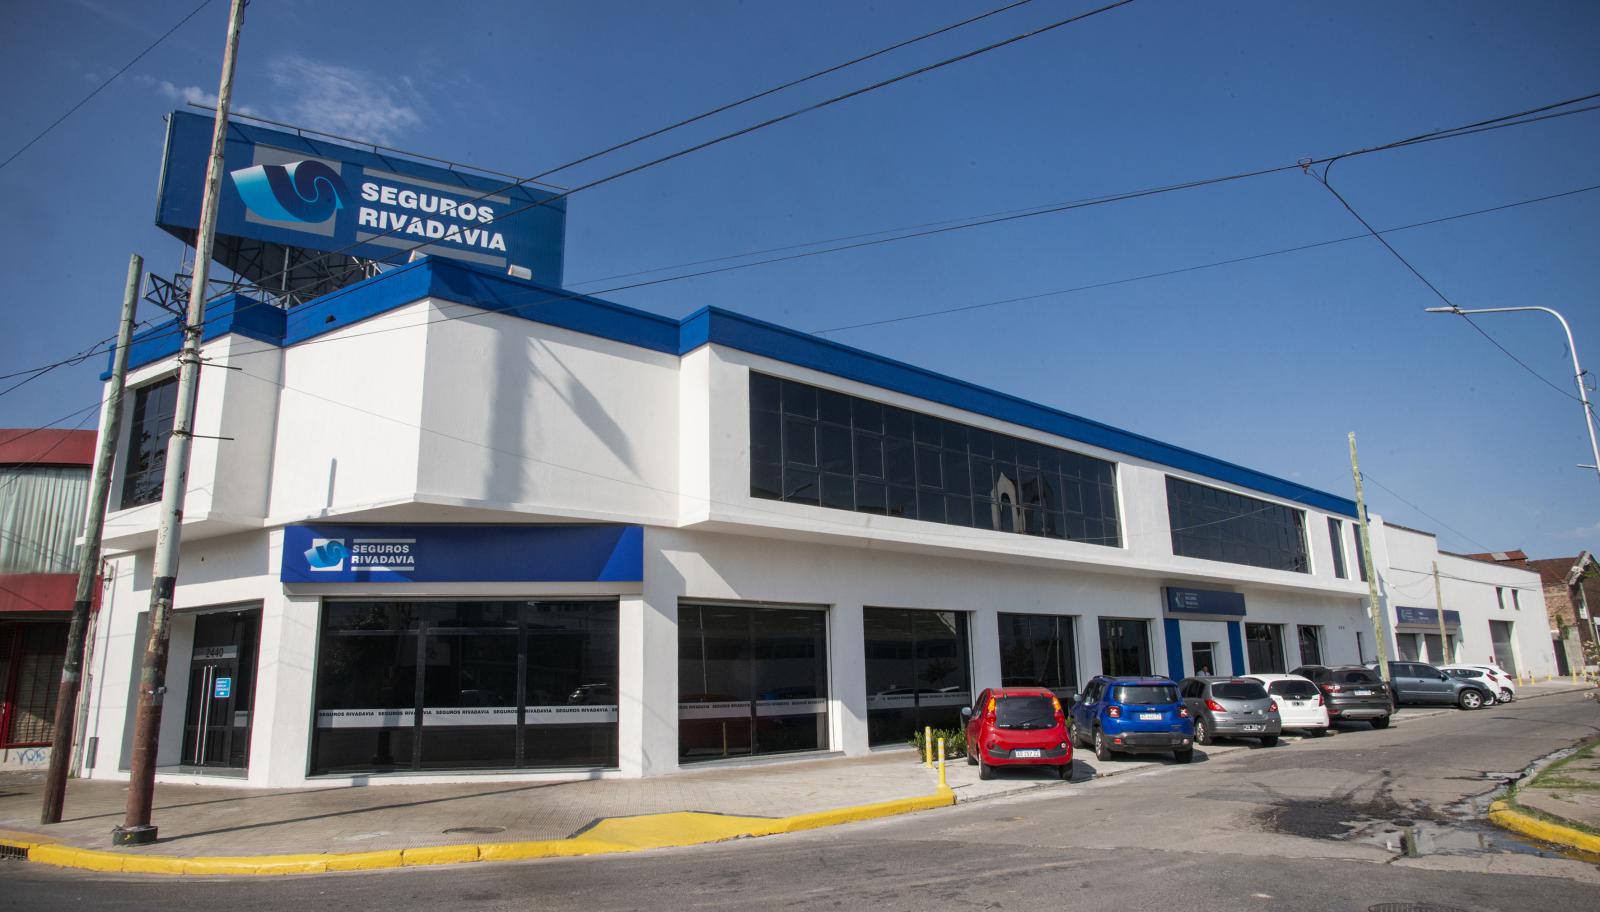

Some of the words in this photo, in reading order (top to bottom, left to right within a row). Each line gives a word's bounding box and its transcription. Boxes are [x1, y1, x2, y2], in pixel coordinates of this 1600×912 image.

[360, 182, 495, 224] SEGUROS
[358, 207, 507, 251] RIVADAVIA
[351, 555, 415, 564] RIVADAVIA
[352, 544, 410, 553] SEGUROS
